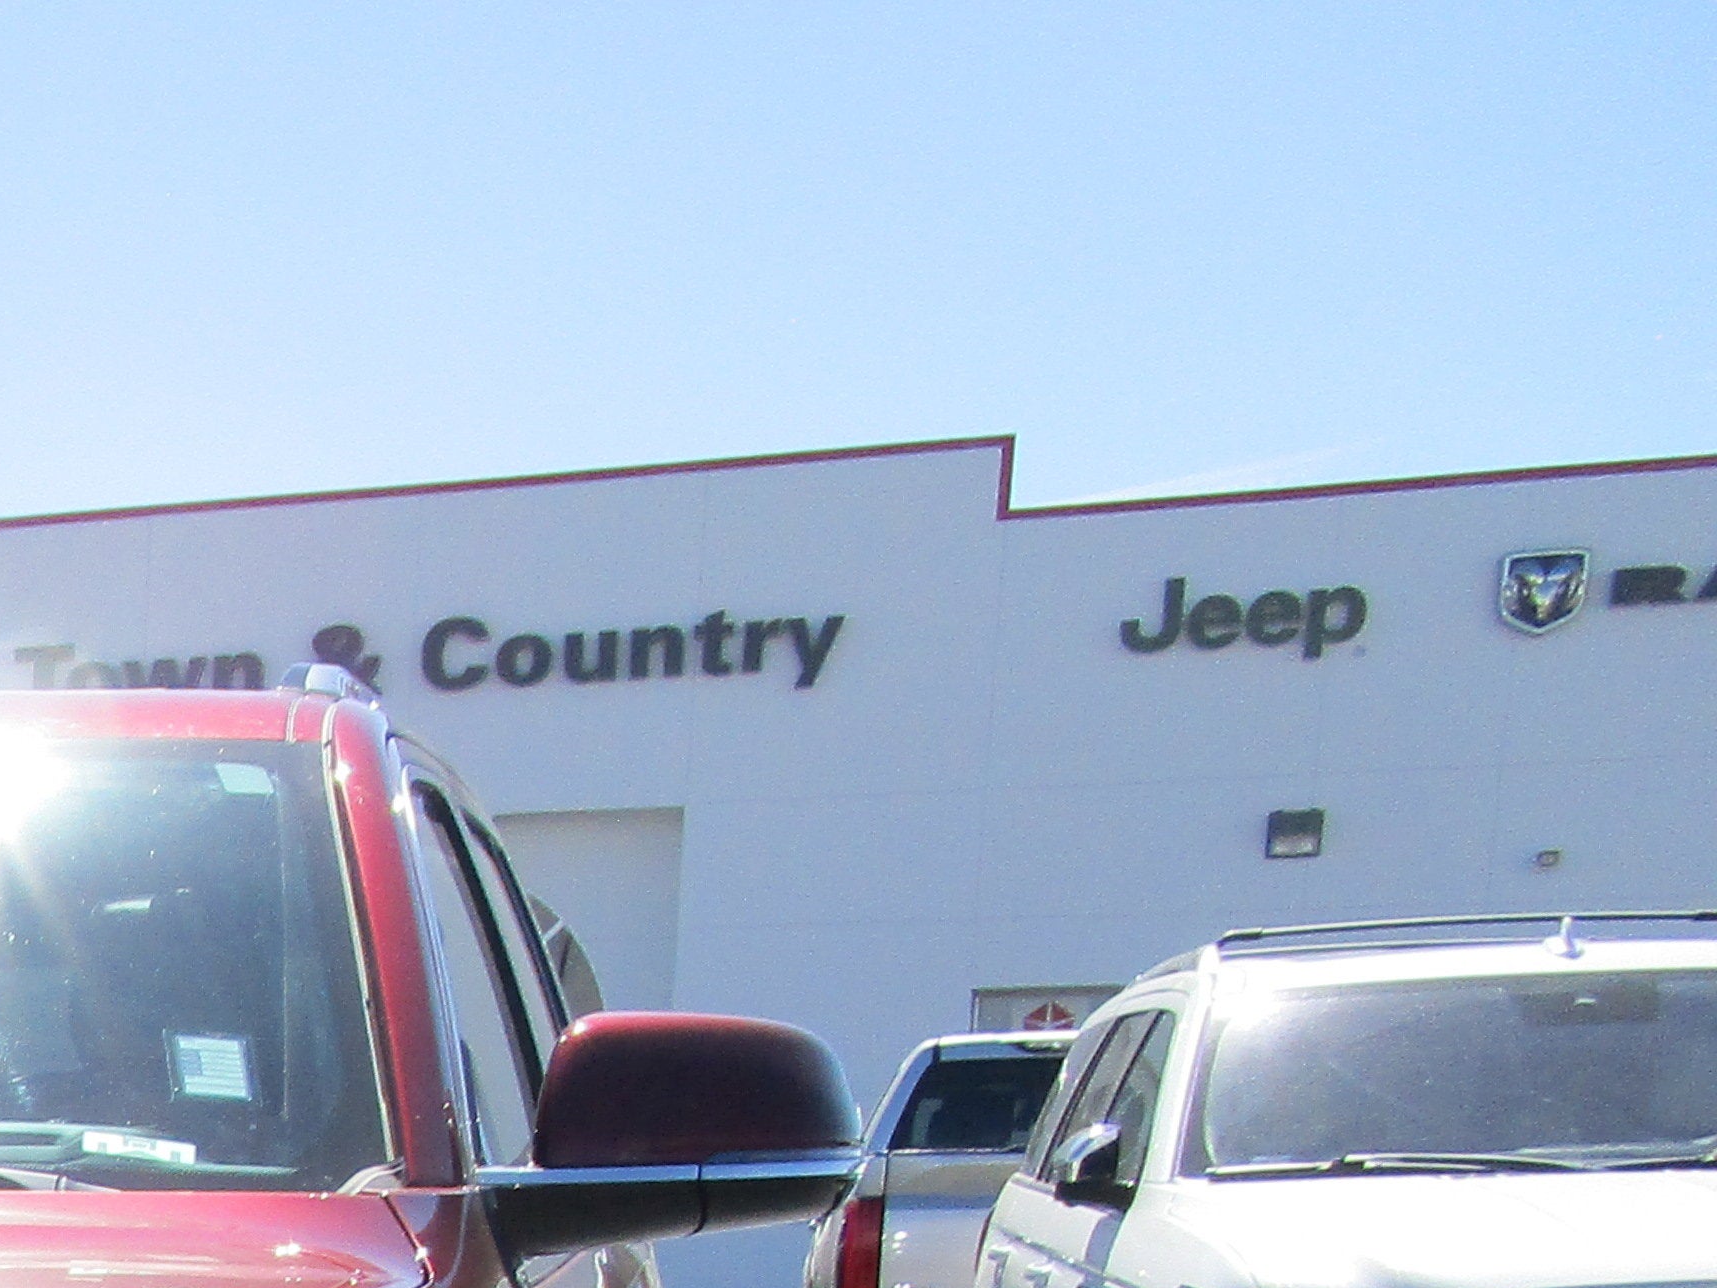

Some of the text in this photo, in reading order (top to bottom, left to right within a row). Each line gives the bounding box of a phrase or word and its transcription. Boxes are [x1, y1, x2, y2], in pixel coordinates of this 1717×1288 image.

[13, 643, 264, 689] Town
[422, 609, 845, 691] Country
[1120, 576, 1368, 659] Jeep
